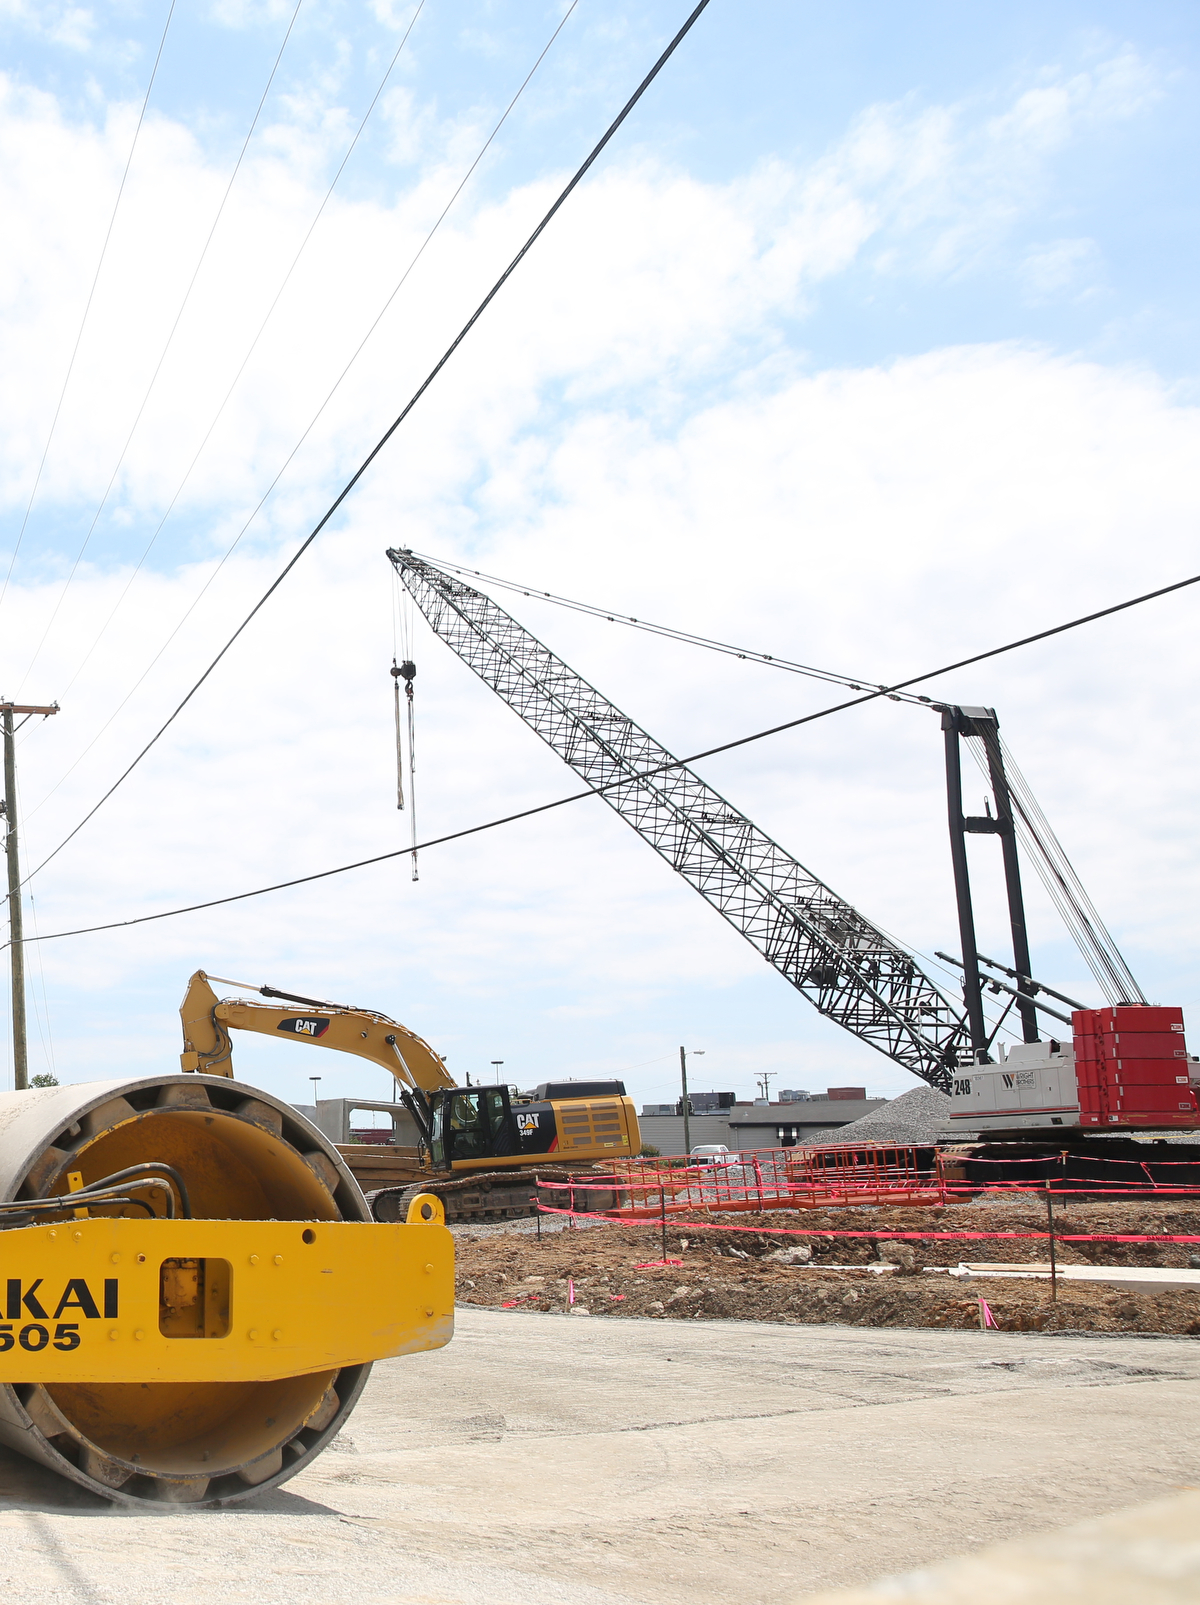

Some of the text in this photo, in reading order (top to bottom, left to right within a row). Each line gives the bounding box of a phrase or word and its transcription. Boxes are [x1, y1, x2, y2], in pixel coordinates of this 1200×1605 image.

[295, 1018, 317, 1036] CAT
[953, 1078, 971, 1096] 248
[516, 1113, 540, 1130] CAT
